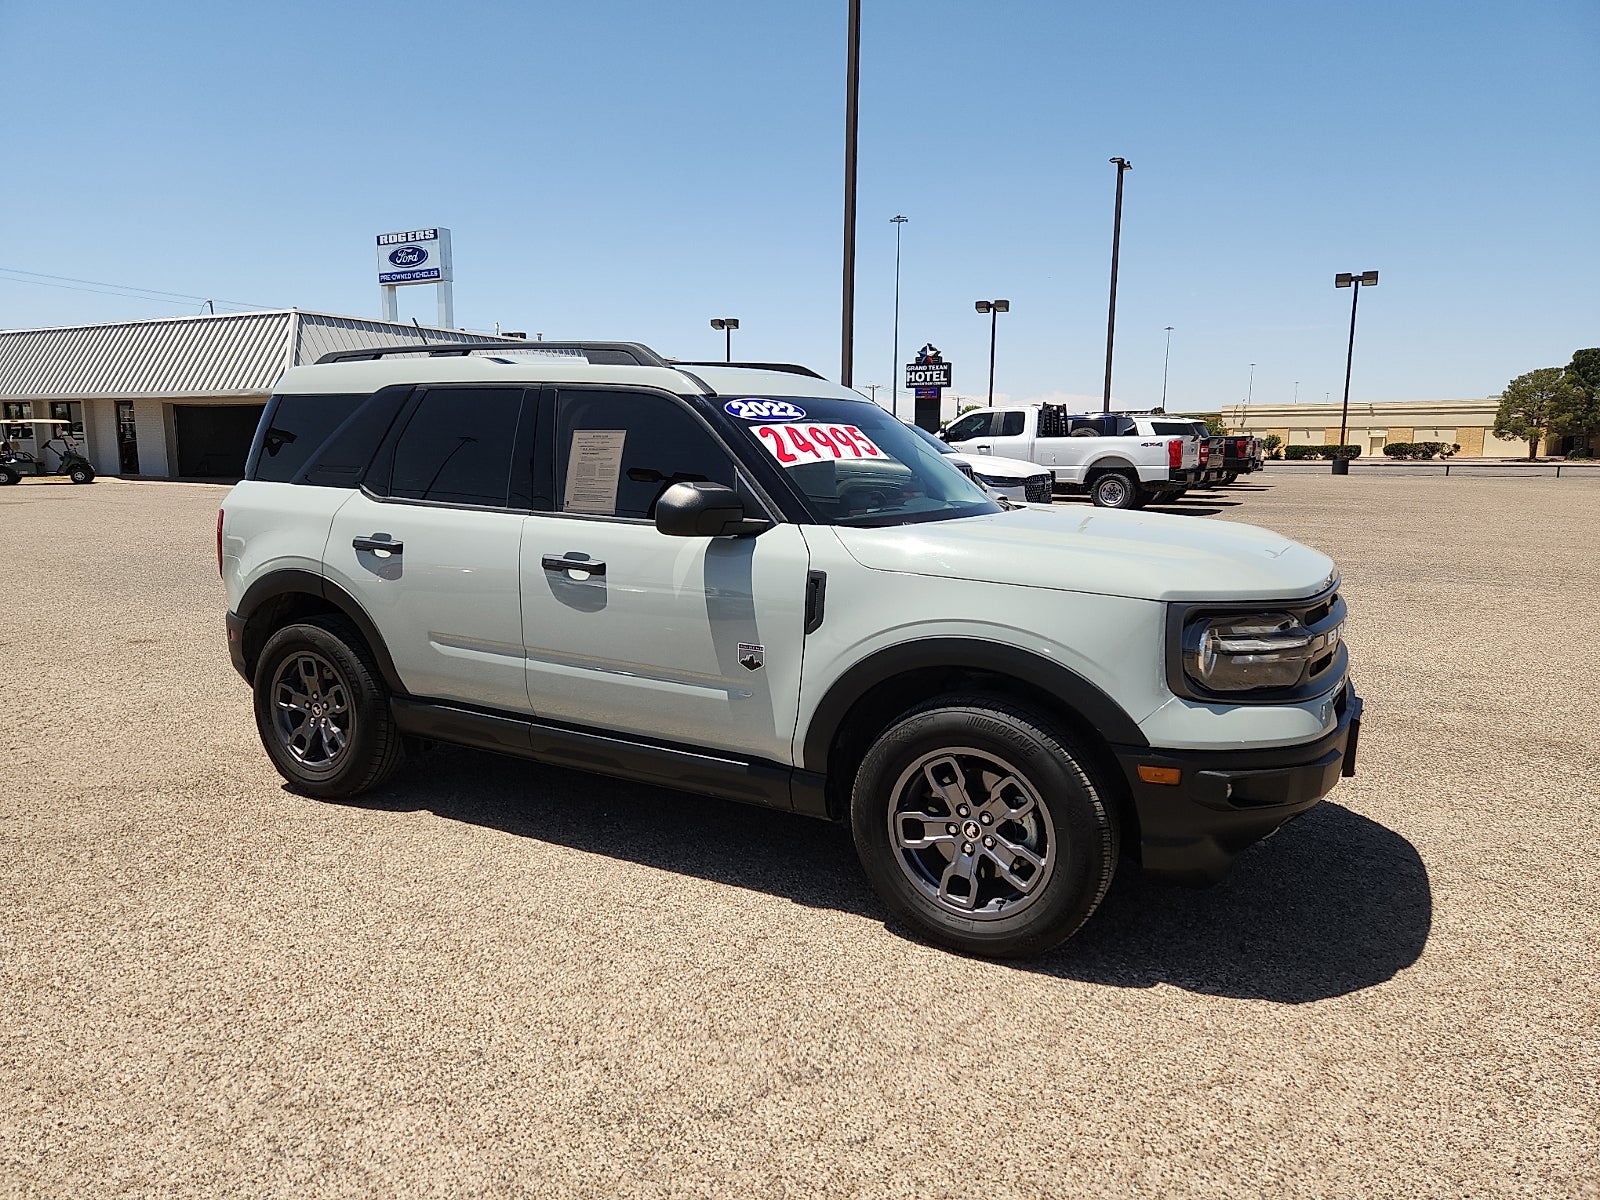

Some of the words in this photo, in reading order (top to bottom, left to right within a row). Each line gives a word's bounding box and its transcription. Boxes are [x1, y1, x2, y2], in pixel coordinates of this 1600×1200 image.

[379, 229, 434, 244] ROGERS
[396, 248, 419, 263] Ford
[380, 273, 411, 282] PRE-OWNED
[412, 270, 438, 279] VEHICLES
[906, 371, 948, 382] HOTEL
[730, 401, 802, 417] 2022
[759, 426, 877, 463] 24995
